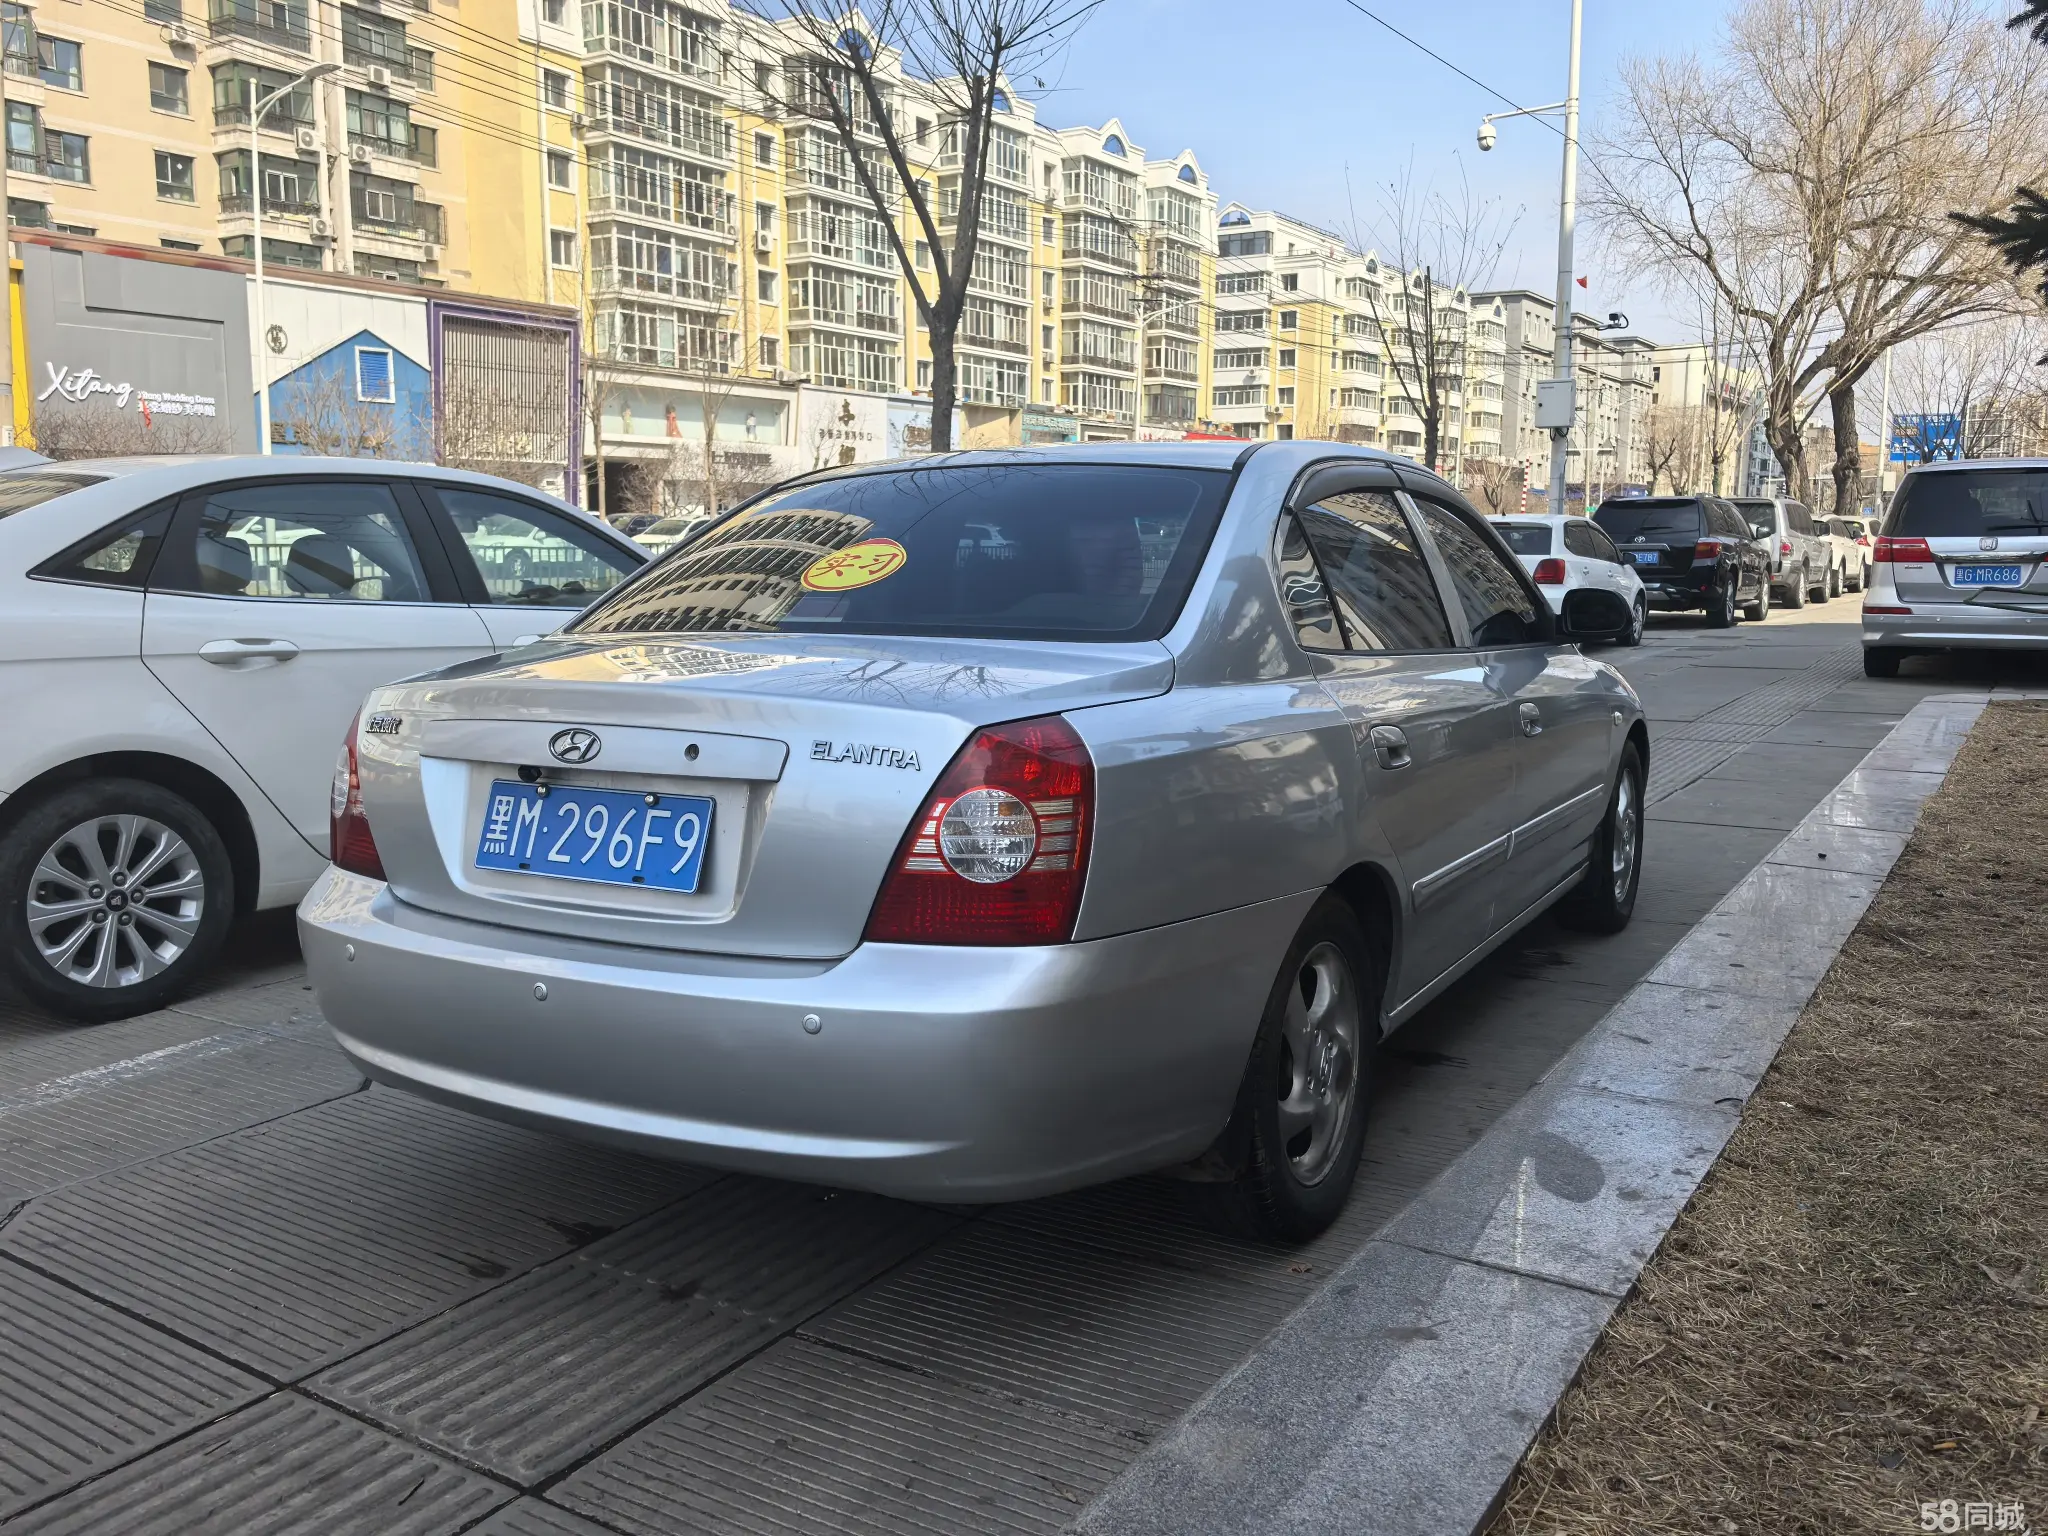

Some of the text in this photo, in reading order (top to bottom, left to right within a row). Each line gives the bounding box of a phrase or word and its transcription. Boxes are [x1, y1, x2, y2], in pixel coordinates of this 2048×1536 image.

[38, 361, 134, 408] Xitang
[163, 393, 194, 404] Wedding
[195, 395, 215, 404] Dress
[1955, 568, 2020, 582] 黑G·MR686
[810, 740, 921, 772] ELANTRA
[483, 795, 701, 875] 黑M·296F9
